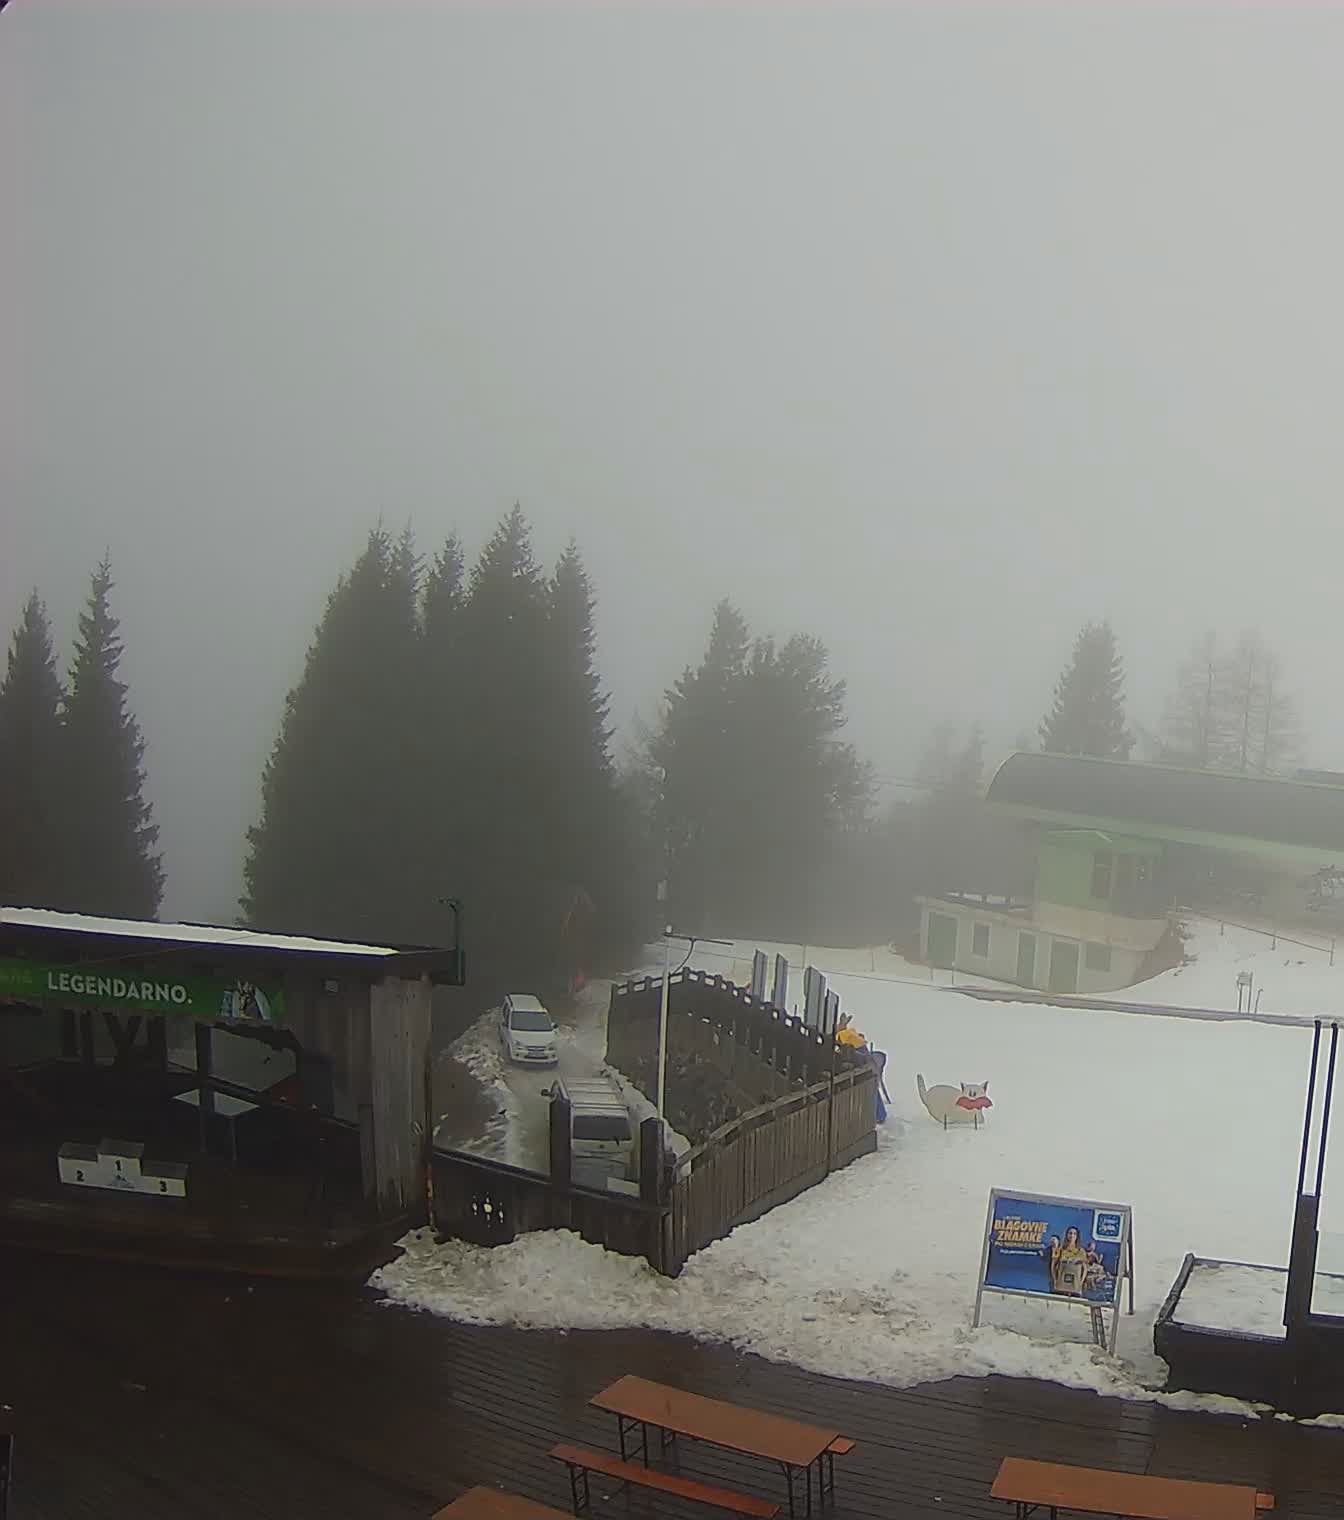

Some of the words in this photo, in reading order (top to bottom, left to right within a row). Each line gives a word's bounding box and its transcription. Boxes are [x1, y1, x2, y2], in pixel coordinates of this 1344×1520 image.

[48, 971, 193, 1005] LEGENDARNO.
[115, 1159, 122, 1172] 1
[76, 1169, 85, 1182] 2
[159, 1180, 168, 1193] 3
[994, 1219, 1049, 1233] BLAGOVNE
[997, 1230, 1043, 1243] ZNAMKE
